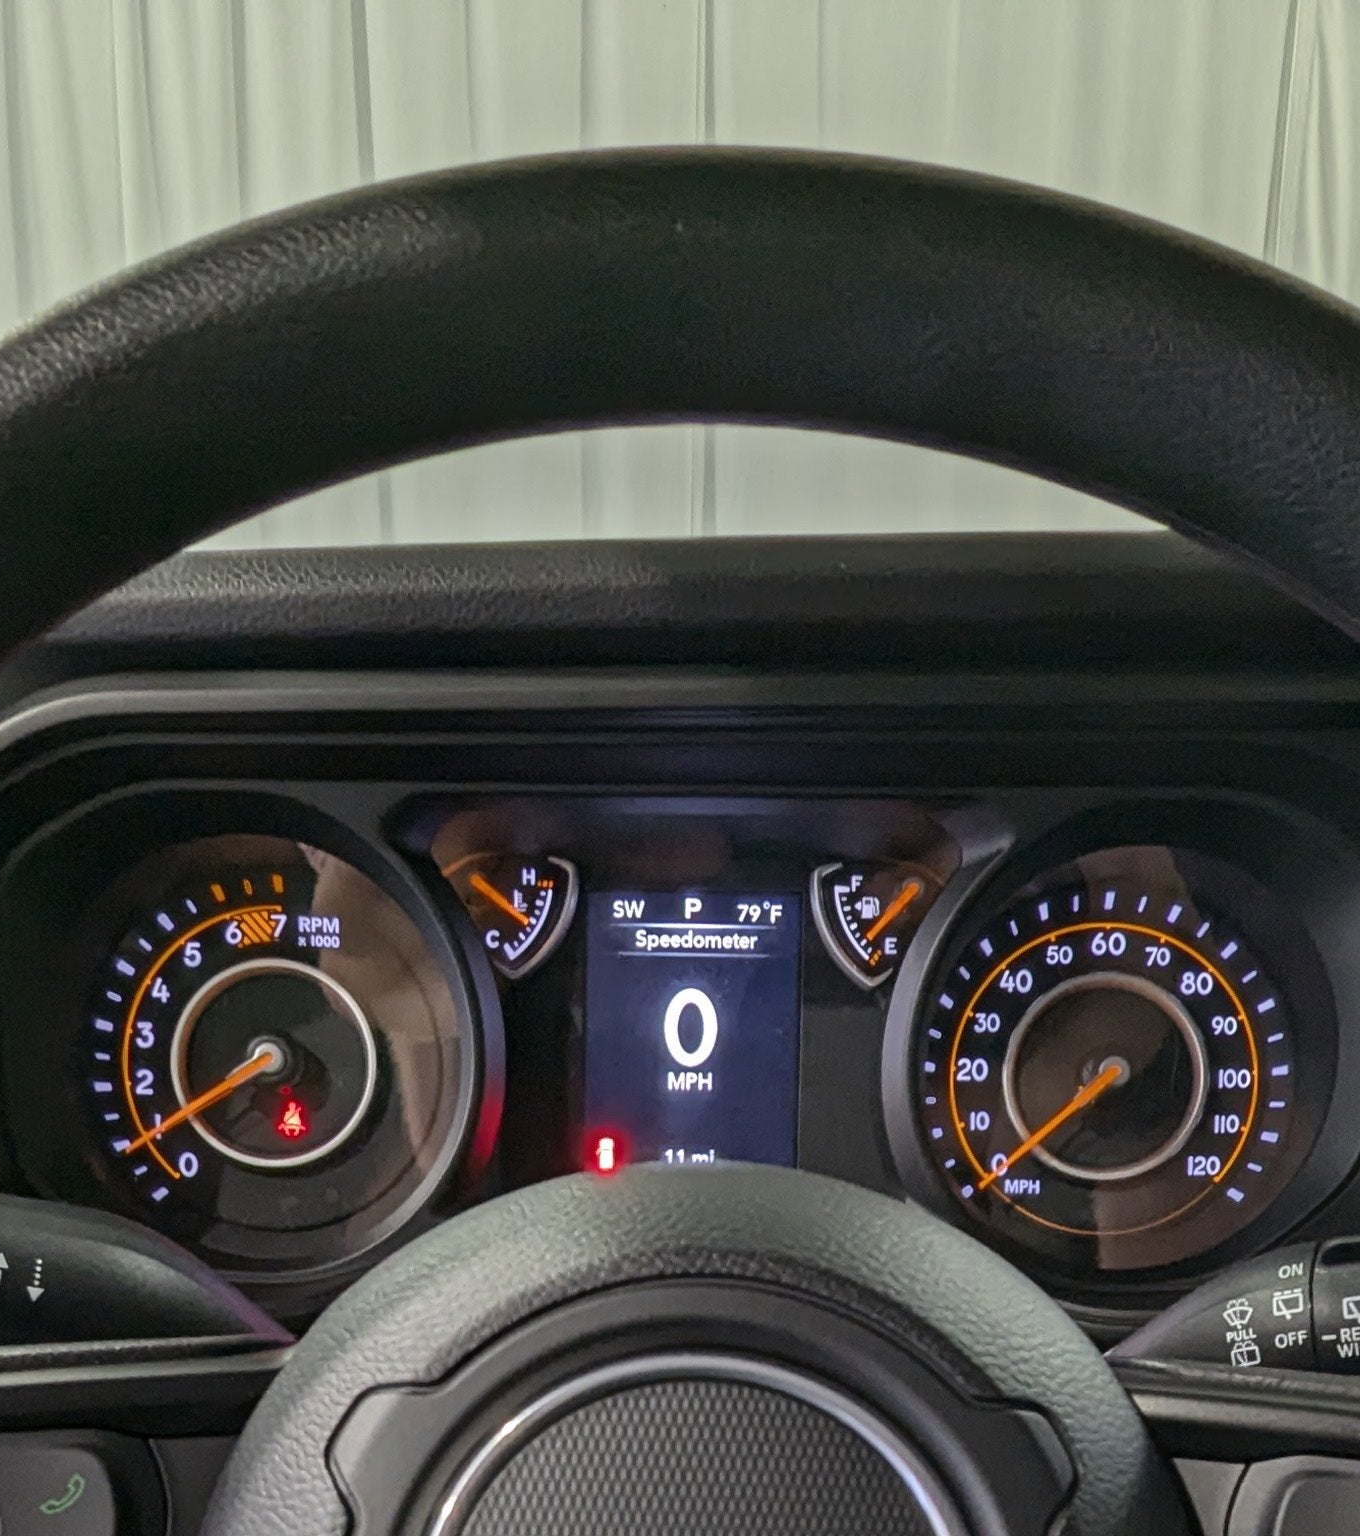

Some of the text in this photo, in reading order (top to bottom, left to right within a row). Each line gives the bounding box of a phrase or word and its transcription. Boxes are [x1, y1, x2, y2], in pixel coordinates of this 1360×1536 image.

[522, 867, 536, 886] H
[851, 876, 862, 892] F
[612, 898, 782, 923] SW P 79°F
[225, 921, 242, 944] 6
[270, 914, 288, 938] 7
[297, 915, 340, 934] RPM
[310, 935, 340, 949] 1000
[485, 929, 499, 949] C
[635, 930, 757, 951] Speedometer
[884, 938, 897, 955] E
[1090, 932, 1126, 957] 60
[183, 942, 202, 968] 5
[1045, 945, 1073, 965] 50
[1145, 946, 1171, 967] 70
[151, 978, 170, 1003] 4
[999, 970, 1033, 994] 40
[1180, 972, 1213, 996] 80
[663, 987, 718, 1067] 0
[973, 1012, 1000, 1033] 30
[1211, 1015, 1238, 1035] 90
[135, 1022, 155, 1048] 3
[957, 1058, 989, 1082] 20
[1217, 1068, 1252, 1089] 100
[136, 1069, 154, 1094] 2
[668, 1072, 713, 1092] MPH
[970, 1111, 990, 1131] 10
[1213, 1114, 1240, 1134] 110
[180, 1153, 198, 1175] 0
[665, 1149, 715, 1164] 11 mi
[990, 1152, 1008, 1176] 0
[1186, 1155, 1221, 1176] 120
[1004, 1178, 1040, 1194] MPH
[1278, 1263, 1304, 1279] ON
[1226, 1327, 1257, 1342] PULL
[1274, 1330, 1308, 1349] OFF
